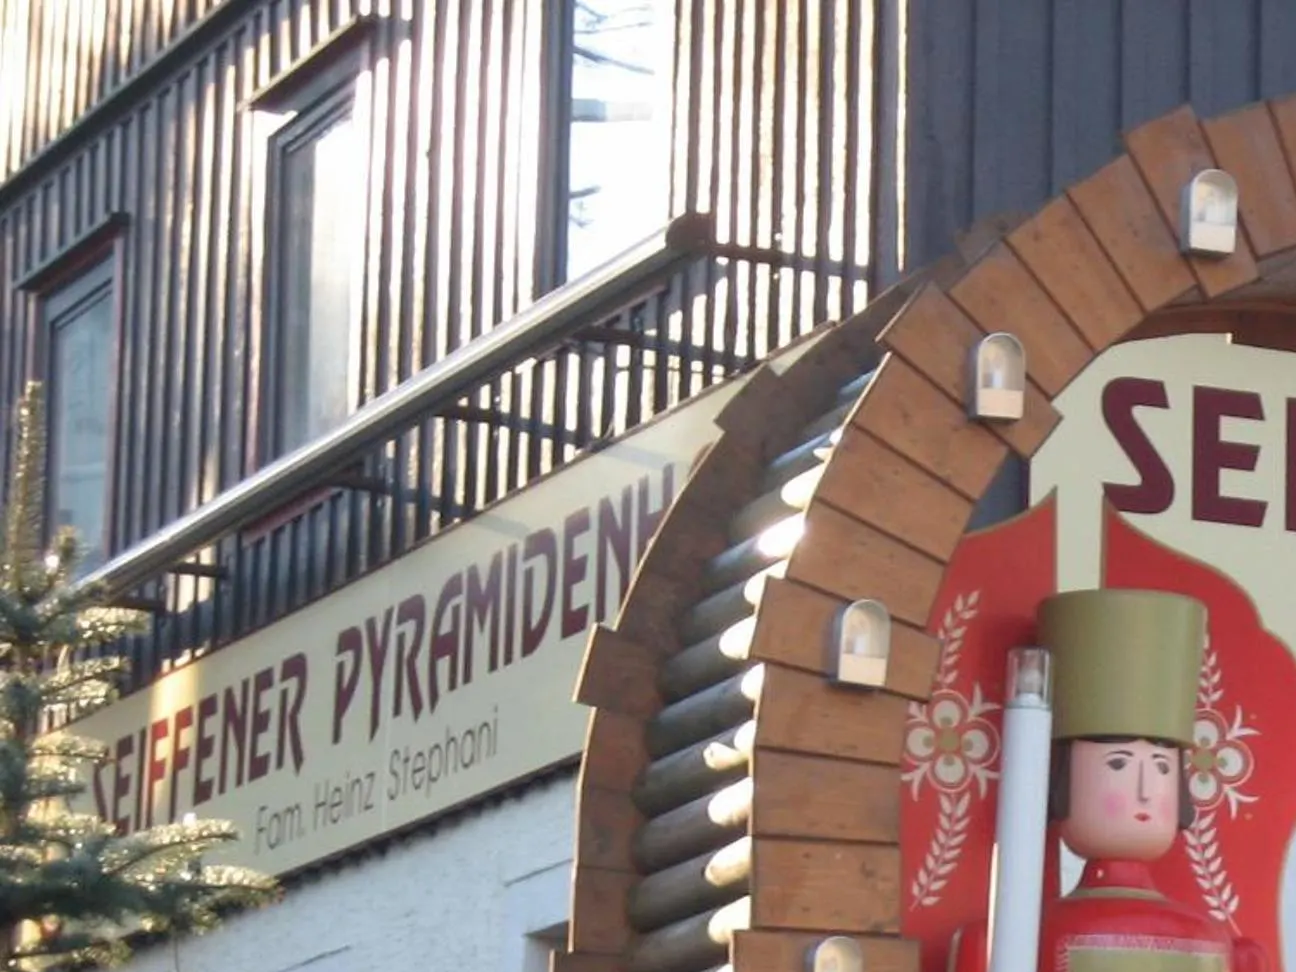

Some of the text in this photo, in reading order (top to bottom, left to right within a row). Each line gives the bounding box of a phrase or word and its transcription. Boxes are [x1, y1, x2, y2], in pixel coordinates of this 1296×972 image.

[253, 705, 499, 855] Fam. Heinz Stephani
